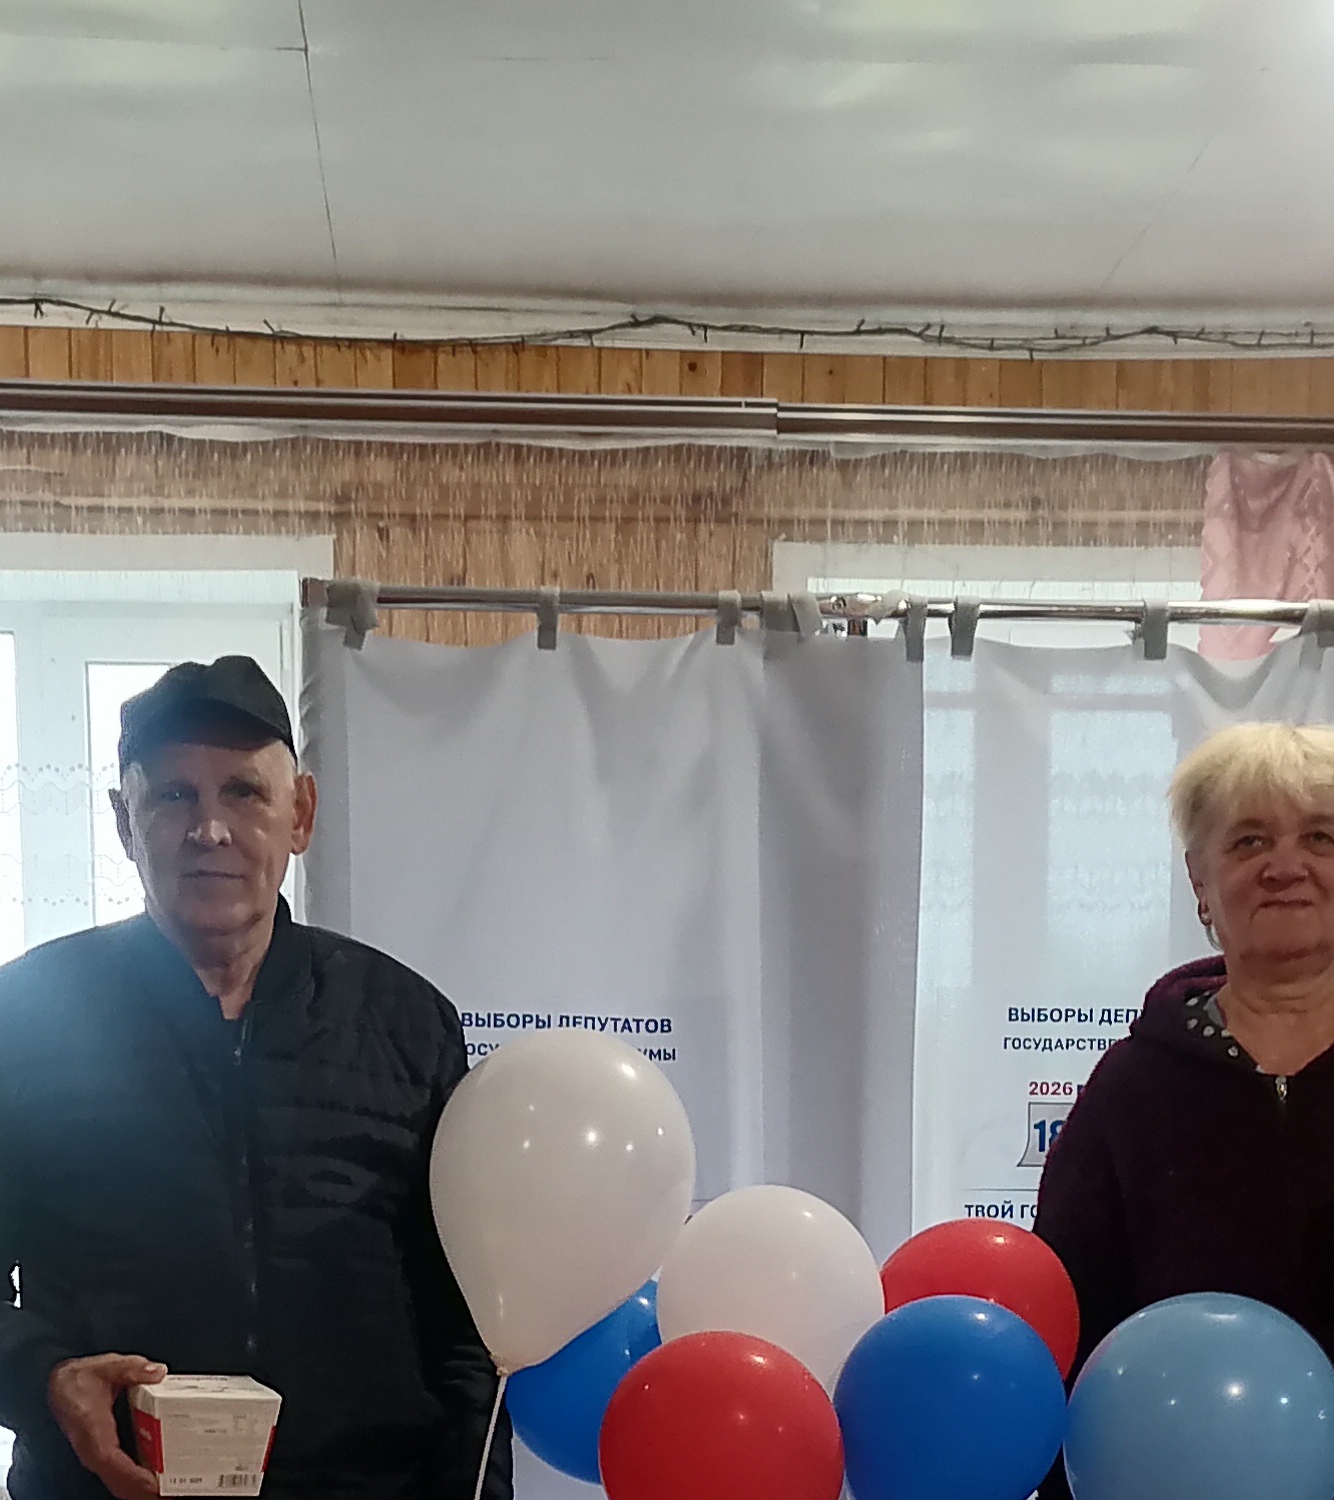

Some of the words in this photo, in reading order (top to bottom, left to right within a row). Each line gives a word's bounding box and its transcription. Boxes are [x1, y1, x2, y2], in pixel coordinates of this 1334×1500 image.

[461, 1012, 551, 1029] ВЫБОРЫ
[558, 1016, 672, 1034] ДЕПУТАТОВ
[1008, 1007, 1093, 1023] ВЫБОРЫ
[1099, 1008, 1144, 1026] ДЕП
[1028, 1081, 1073, 1096] 2026
[964, 1199, 1014, 1219] ТВОЙ
